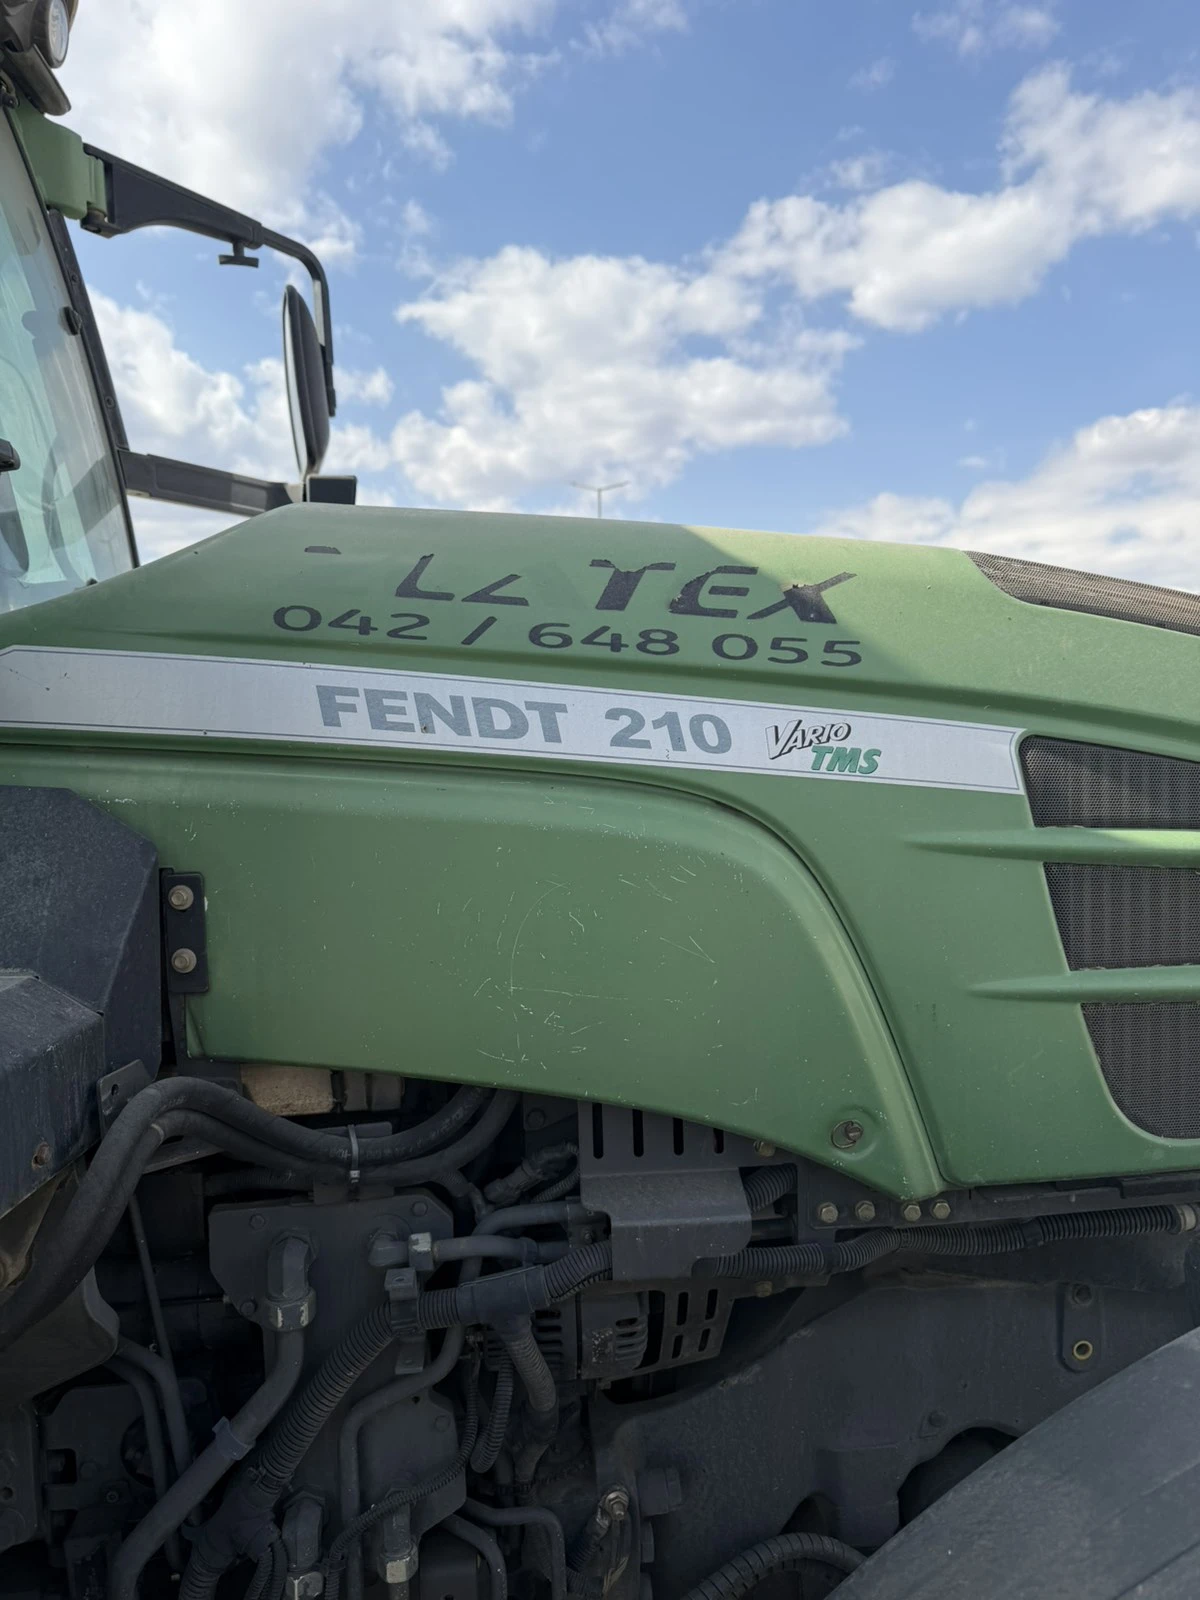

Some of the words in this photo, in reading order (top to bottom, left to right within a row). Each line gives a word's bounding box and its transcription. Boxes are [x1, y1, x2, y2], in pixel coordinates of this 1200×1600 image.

[272, 605, 430, 641] 042
[460, 616, 497, 645] /
[528, 622, 680, 656] 648
[711, 633, 862, 667] 055
[315, 685, 568, 744] FENDT
[604, 707, 732, 754] 210
[810, 745, 882, 774] TMS
